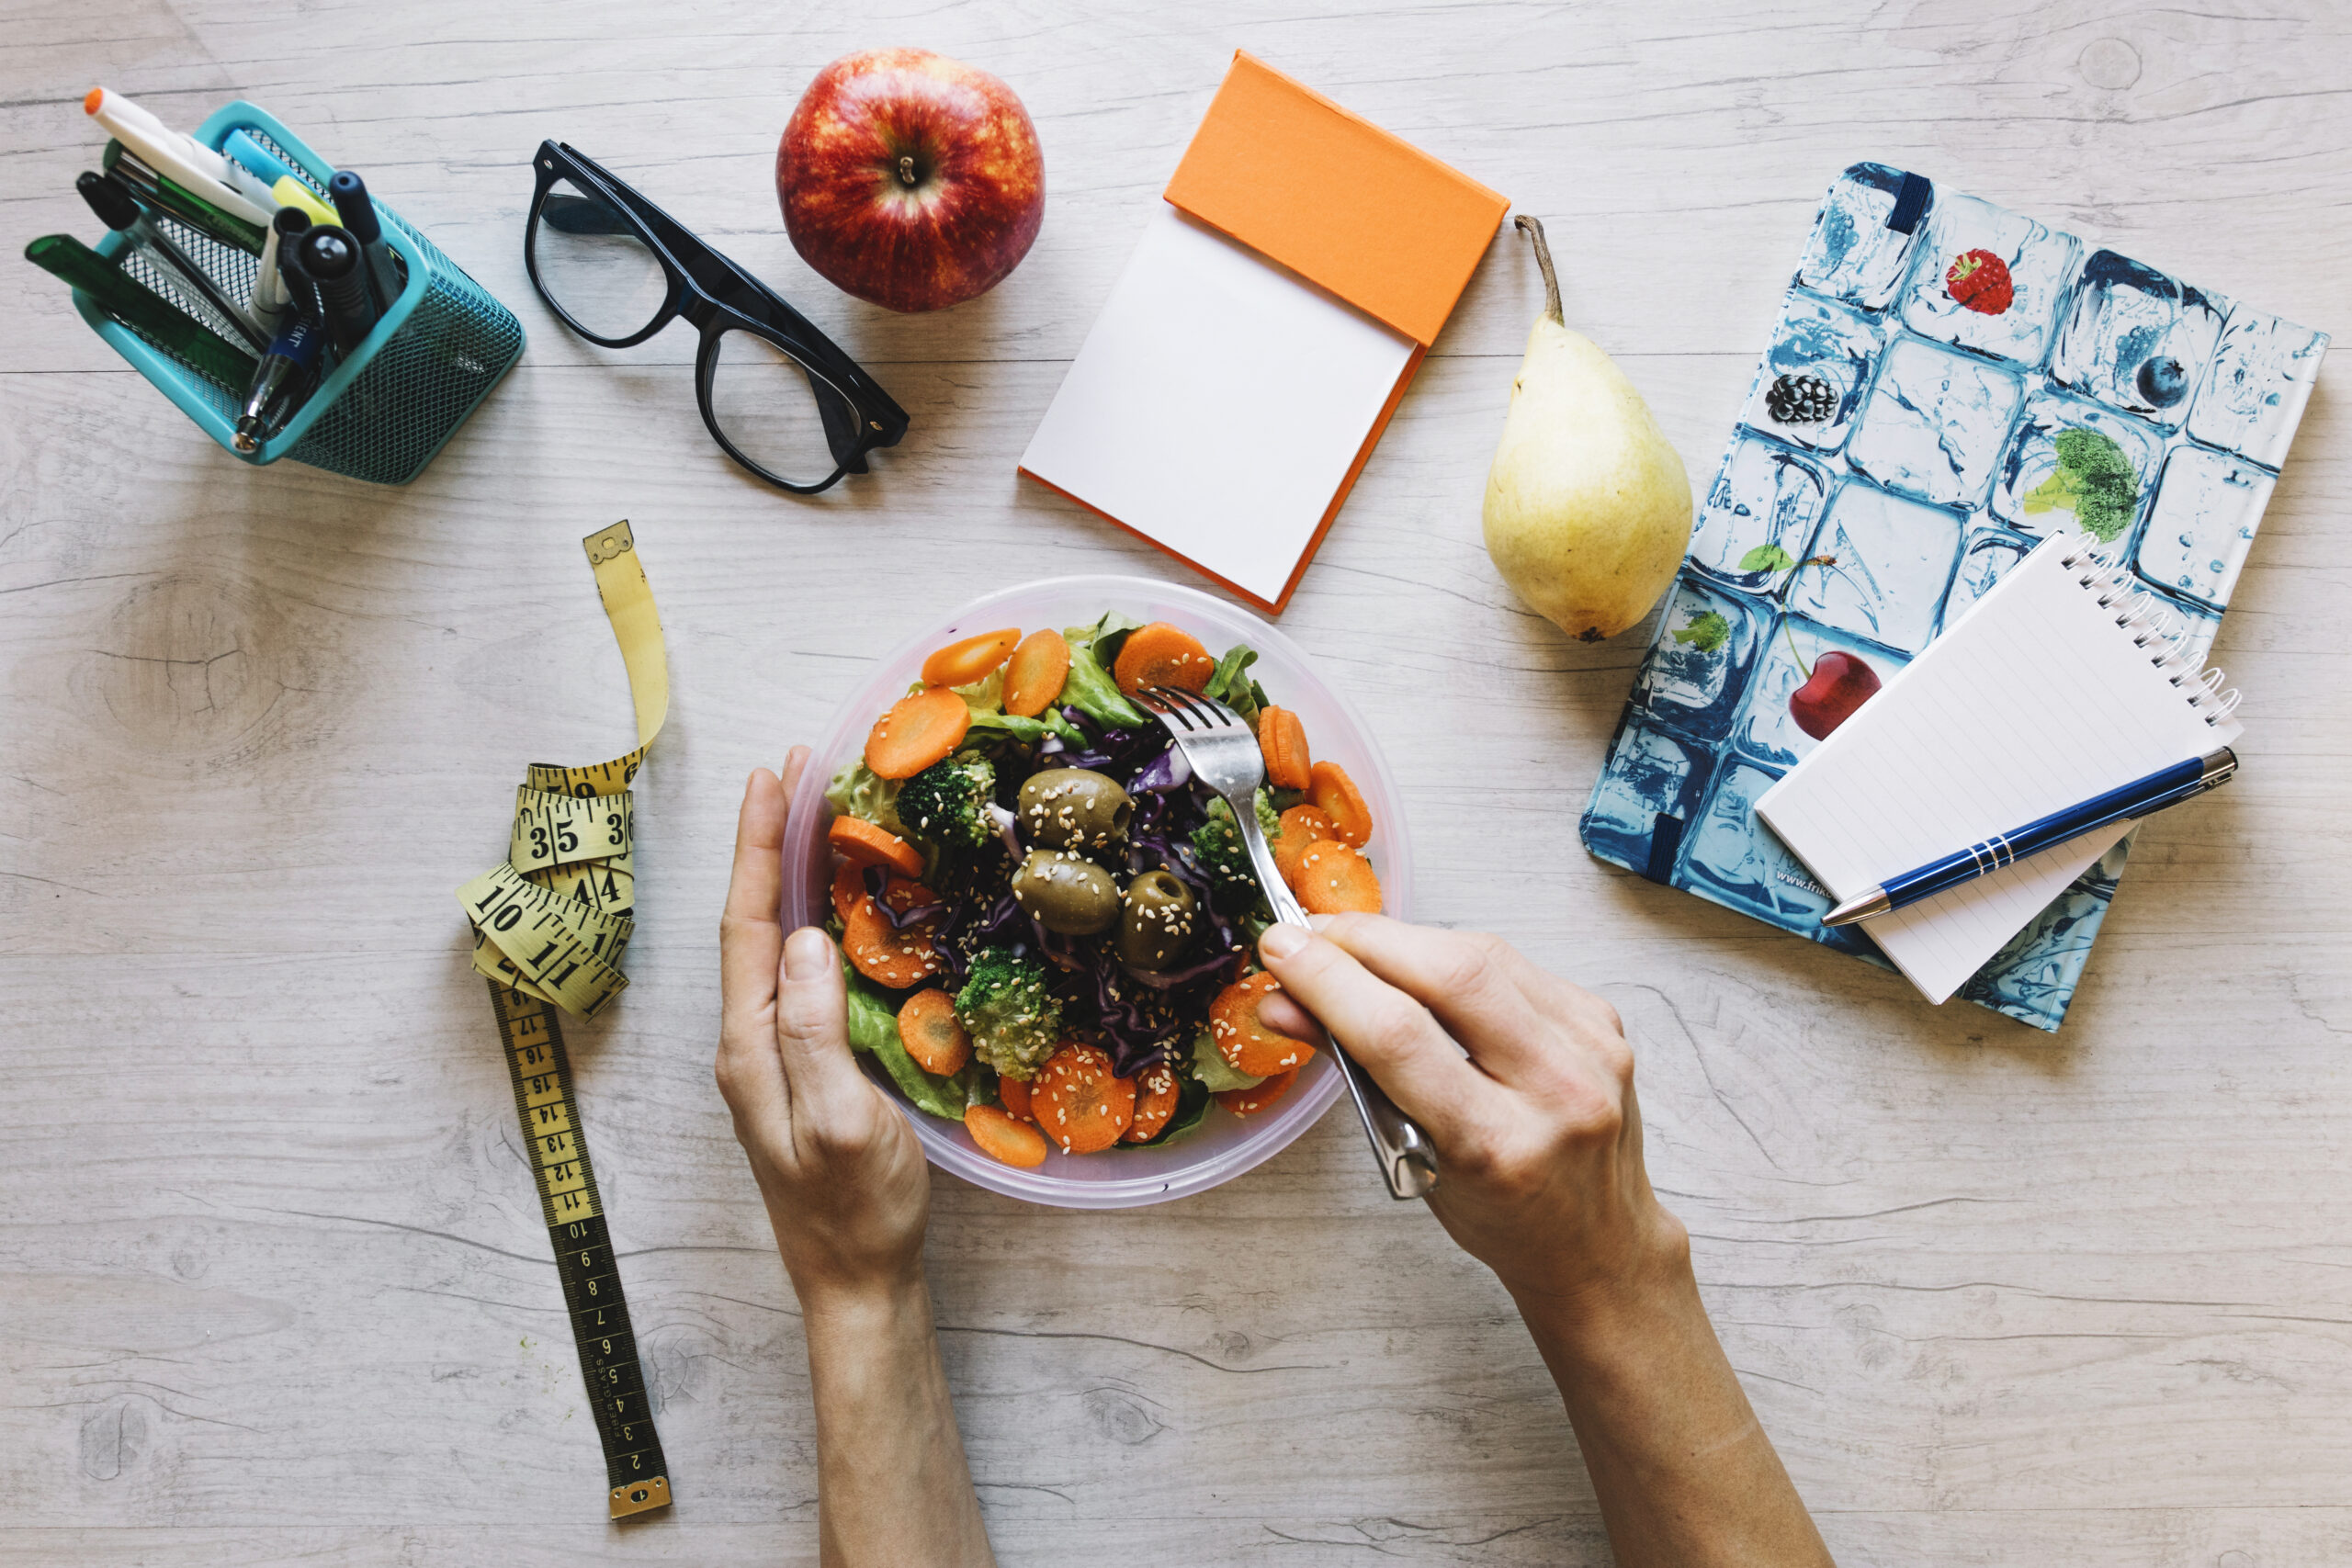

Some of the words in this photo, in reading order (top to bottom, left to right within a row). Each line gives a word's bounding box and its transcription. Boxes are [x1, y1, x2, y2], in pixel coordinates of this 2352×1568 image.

[520, 1017, 537, 1036] 17
[526, 1046, 545, 1066] 16
[532, 1076, 551, 1095] 15
[539, 1105, 558, 1124] 14
[547, 1134, 566, 1154] 13
[553, 1164, 573, 1182] 12
[563, 1192, 581, 1212] 11
[570, 1222, 588, 1239] 10
[581, 1251, 591, 1267] 9
[588, 1280, 598, 1296] 8
[597, 1310, 605, 1325] 7
[602, 1338, 612, 1355] 6
[608, 1368, 618, 1384] 5
[616, 1398, 625, 1413] 4
[624, 1426, 633, 1441] 3
[630, 1454, 641, 1470] 2
